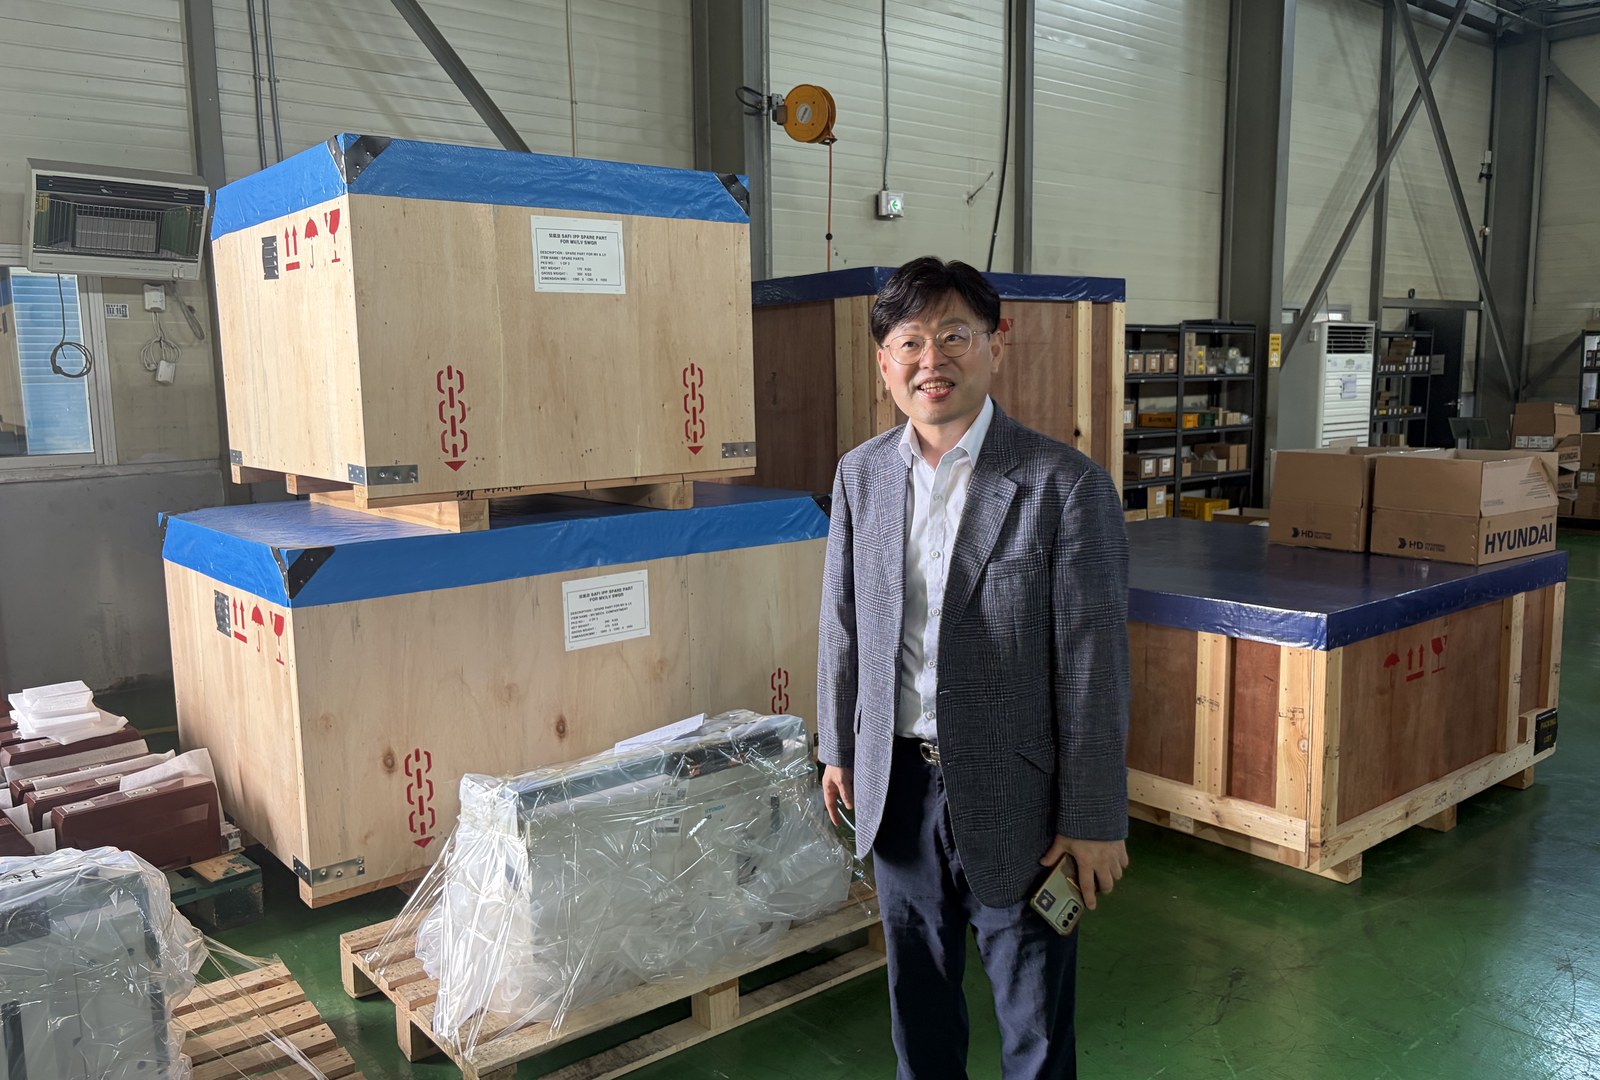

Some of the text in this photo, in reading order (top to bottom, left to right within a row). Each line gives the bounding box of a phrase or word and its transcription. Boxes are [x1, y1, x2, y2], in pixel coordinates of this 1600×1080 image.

[1301, 530, 1314, 538] HD
[1484, 522, 1553, 554] HYUNDAI
[1409, 540, 1424, 550] HD
